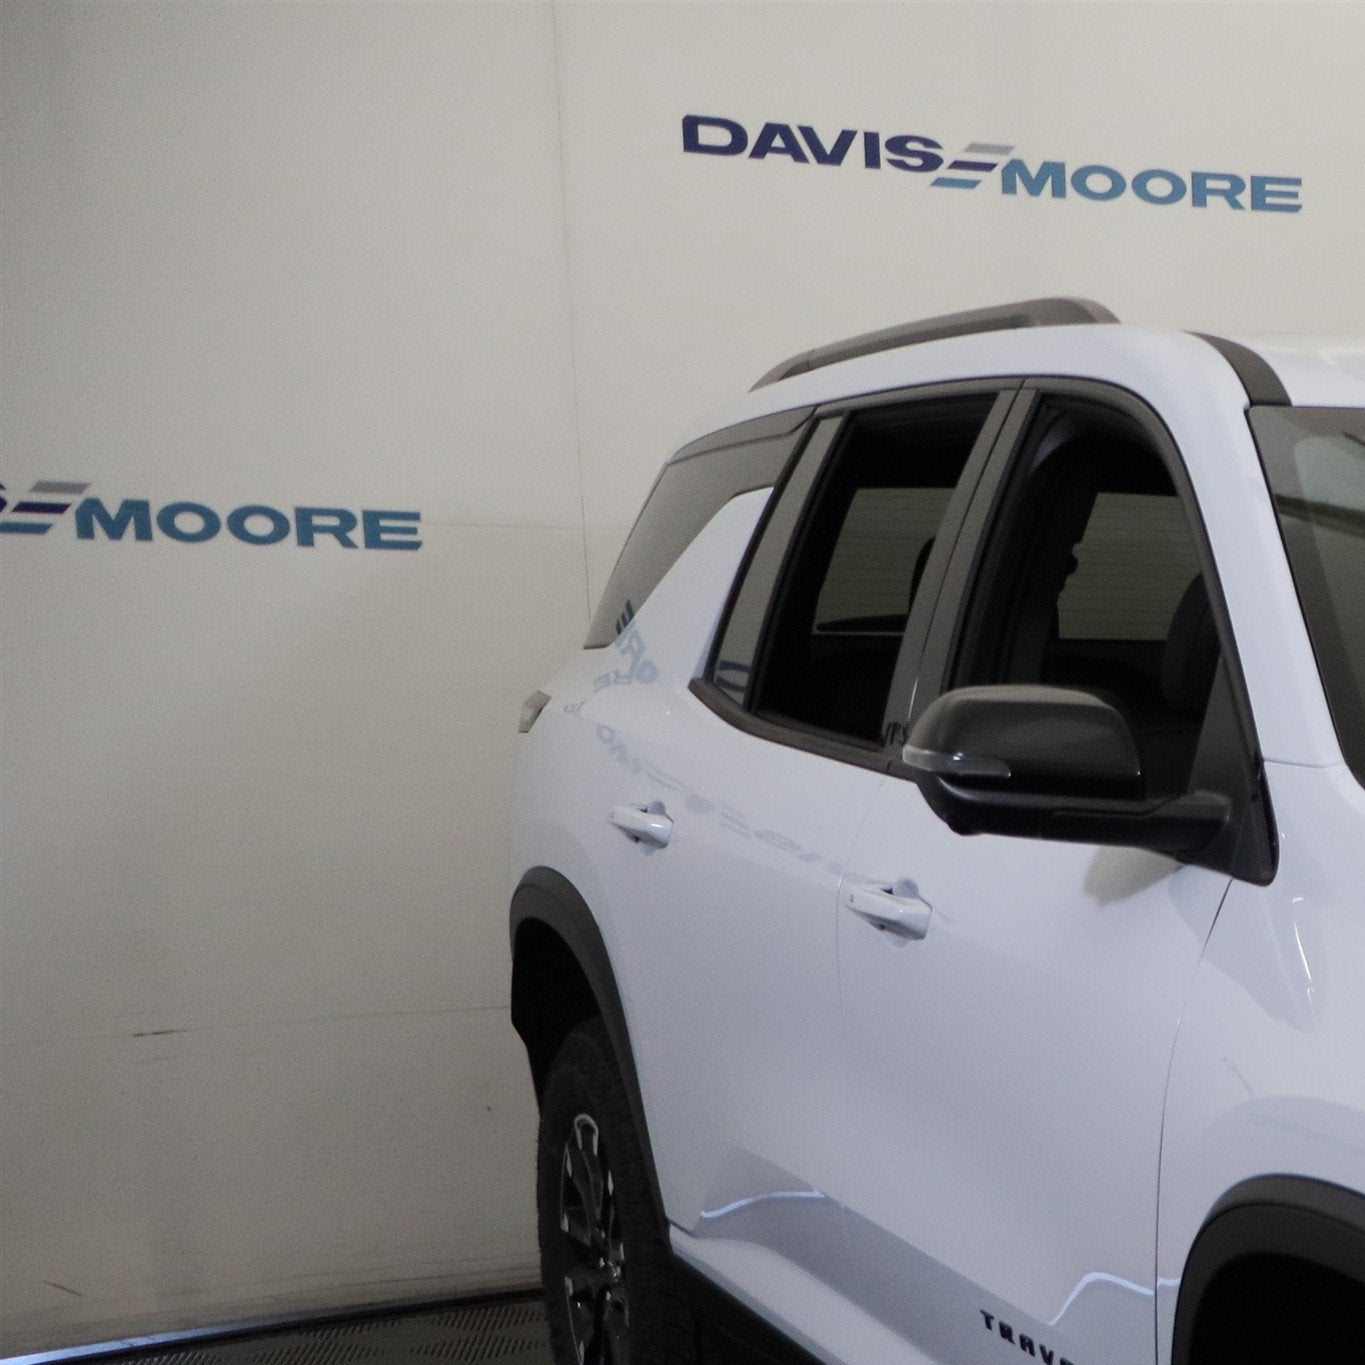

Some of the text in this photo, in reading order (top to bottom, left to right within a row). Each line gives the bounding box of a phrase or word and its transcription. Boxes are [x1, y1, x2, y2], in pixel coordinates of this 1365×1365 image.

[682, 114, 1303, 214] DAVIS MOORE
[75, 497, 423, 551] MOORE
